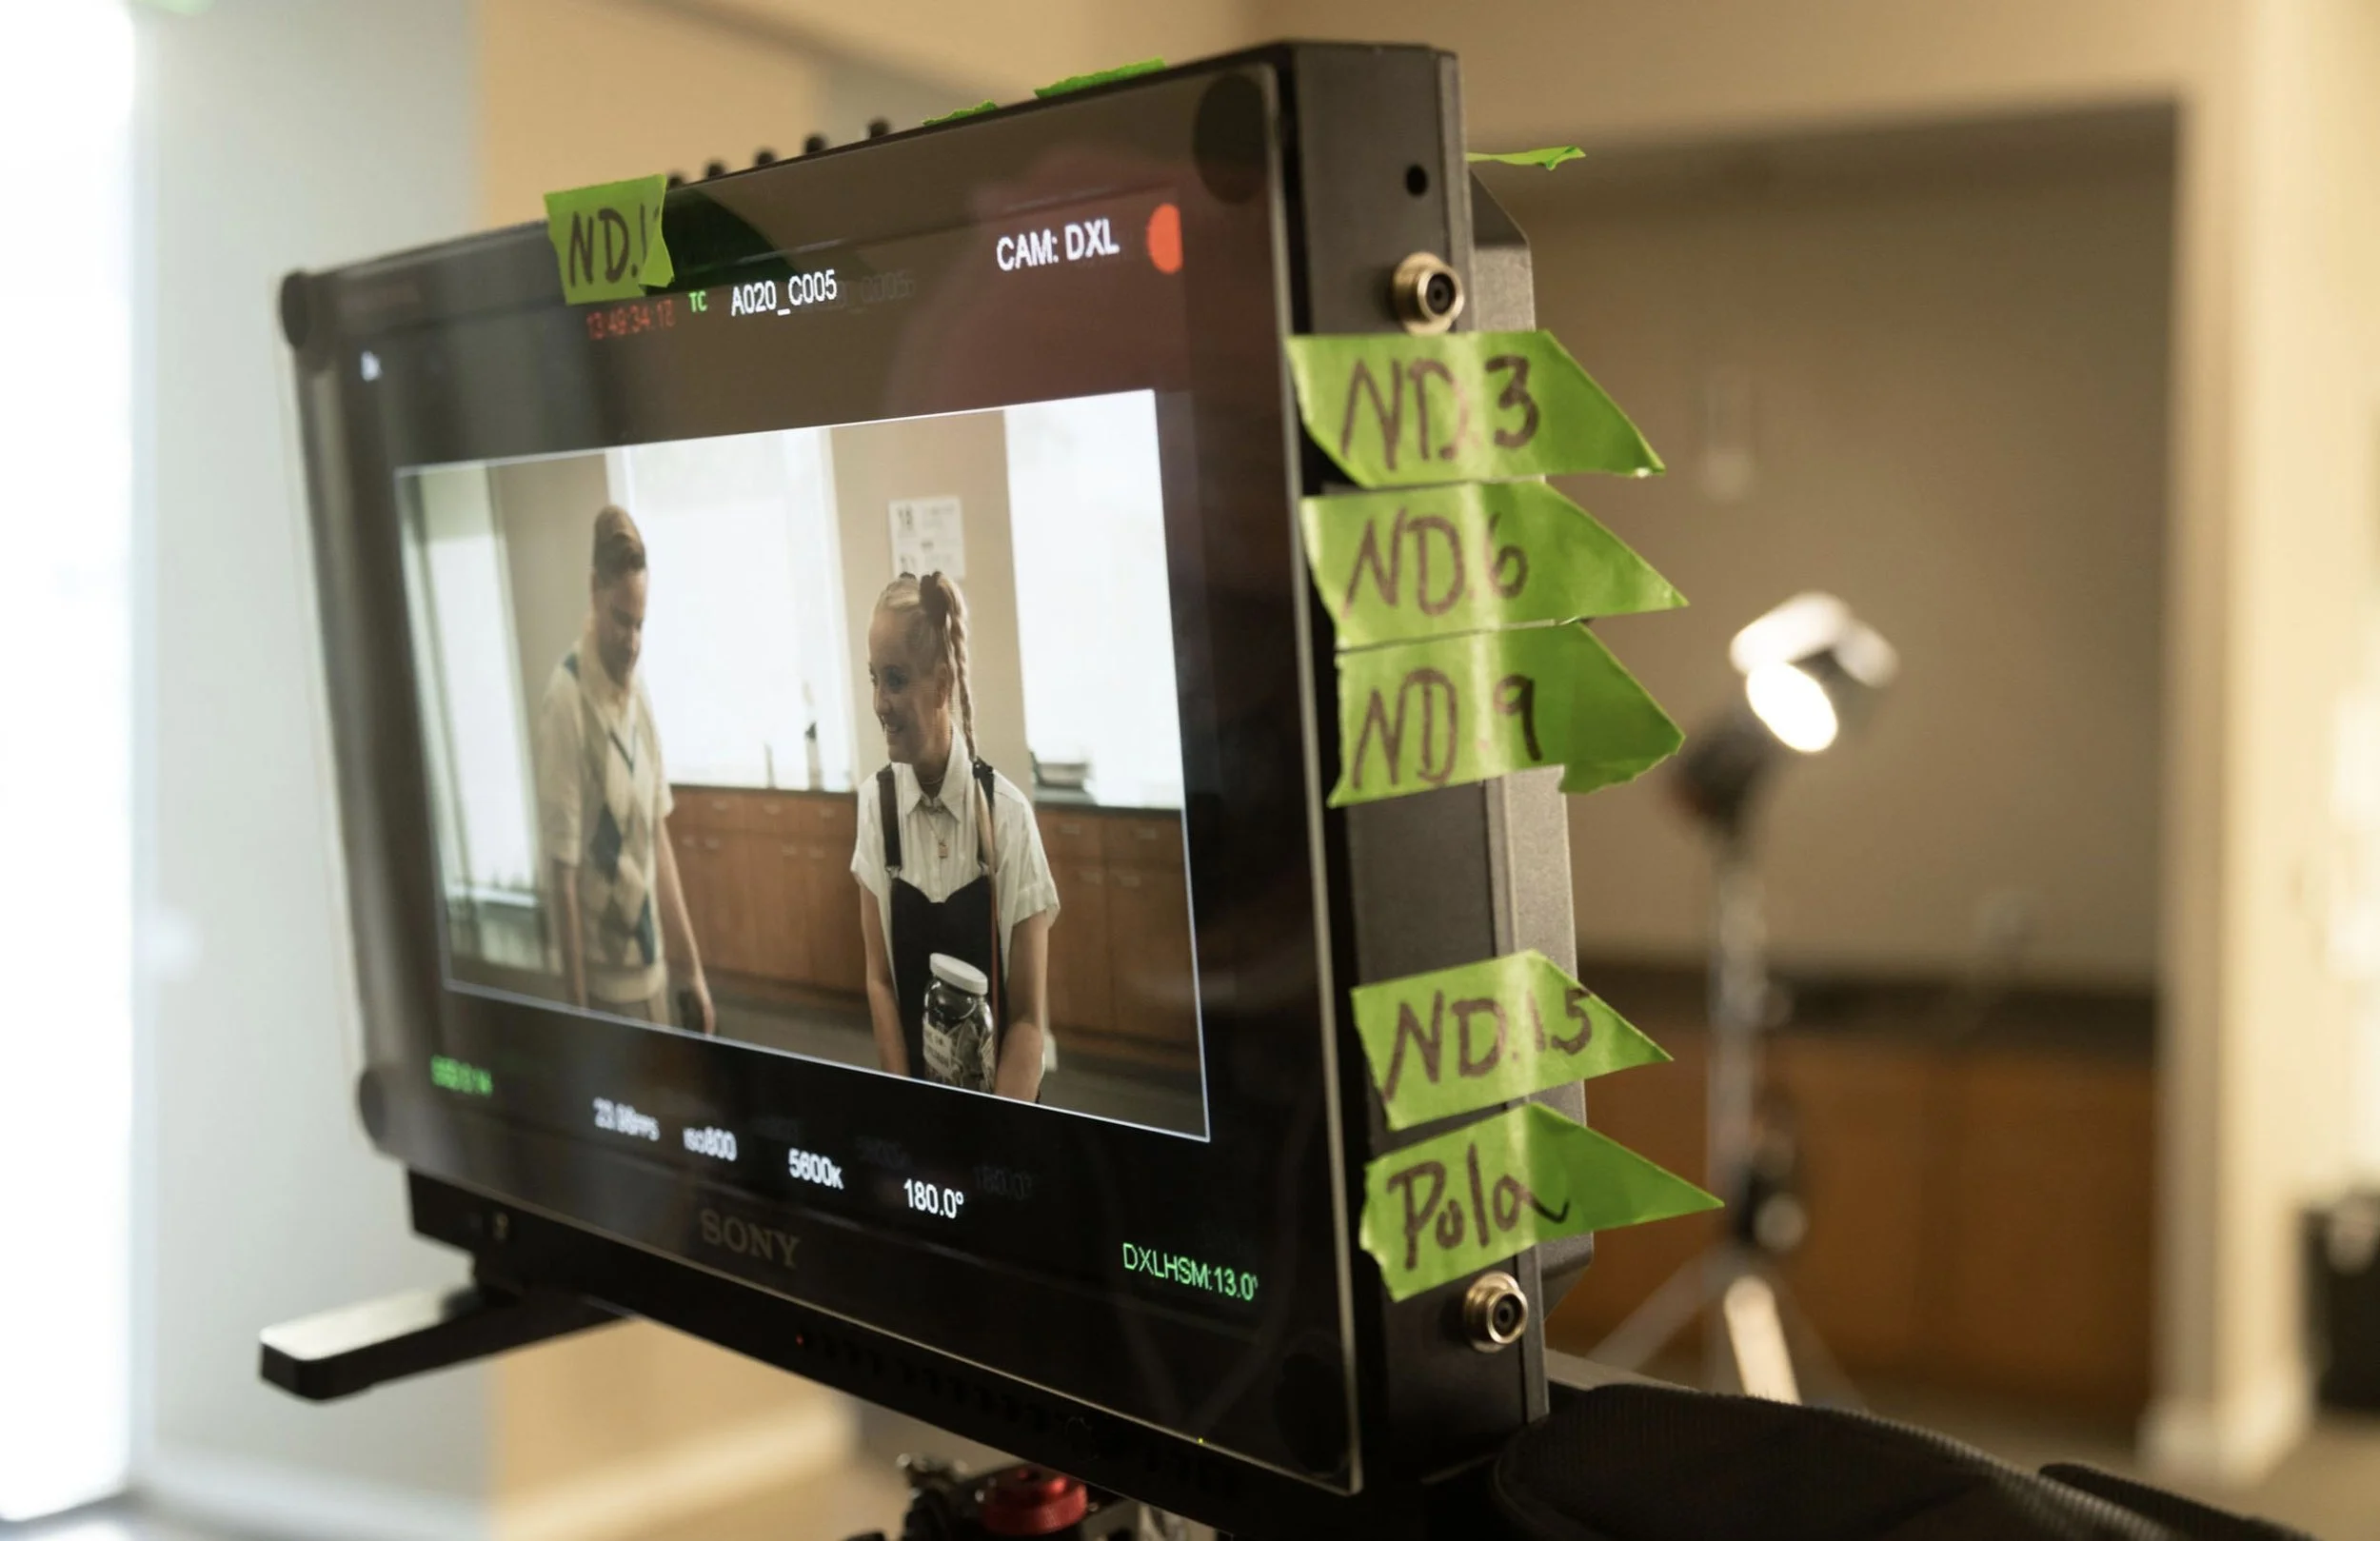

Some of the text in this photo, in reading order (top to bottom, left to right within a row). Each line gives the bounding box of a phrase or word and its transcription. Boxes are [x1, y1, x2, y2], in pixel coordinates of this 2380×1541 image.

[996, 218, 1120, 271] CAM: DXL
[688, 289, 707, 313] TC
[731, 268, 838, 317] A020_C005
[700, 1206, 802, 1271] SONY
